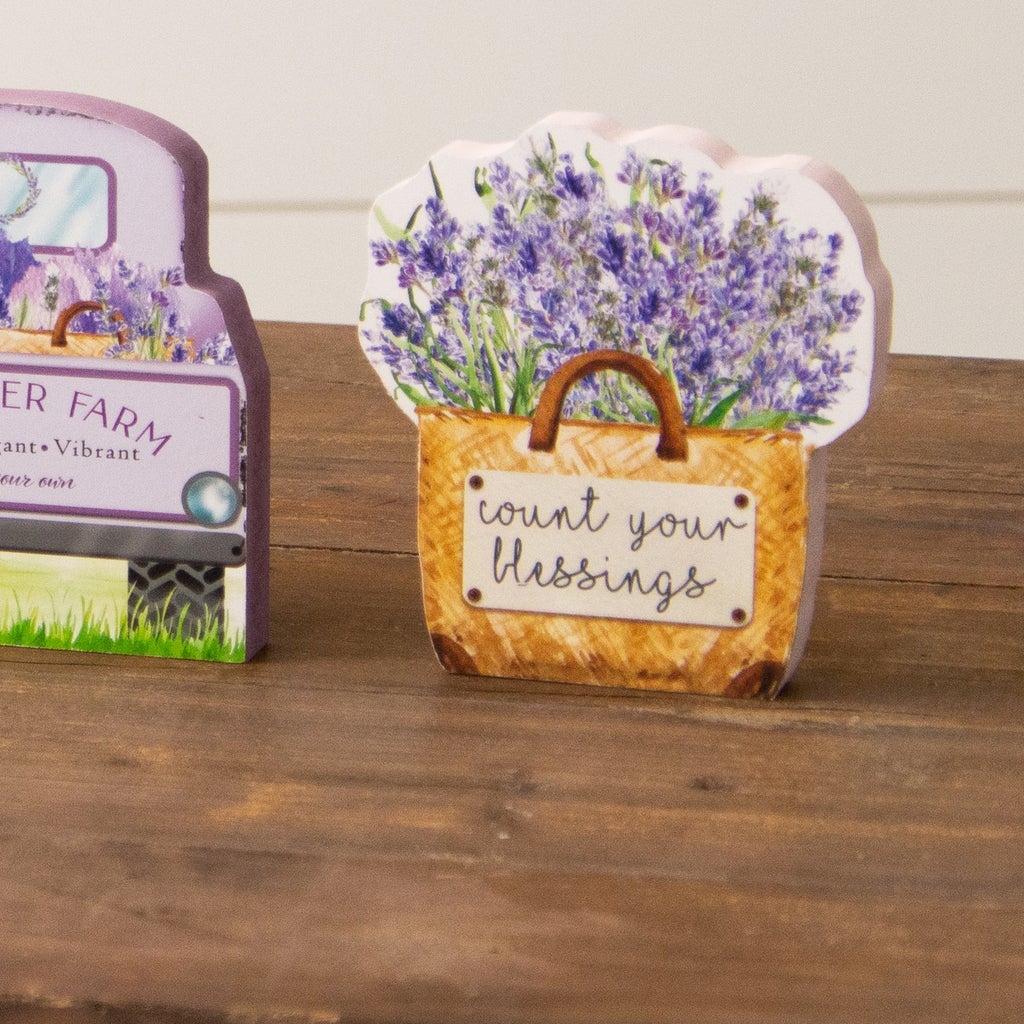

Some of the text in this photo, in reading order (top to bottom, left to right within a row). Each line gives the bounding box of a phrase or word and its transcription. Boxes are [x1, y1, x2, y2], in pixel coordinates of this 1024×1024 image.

[54, 438, 141, 462] Vibrant
[68, 390, 172, 457] FARM
[37, 475, 76, 490] own
[478, 486, 748, 552] count your
[493, 535, 717, 614] blessings
